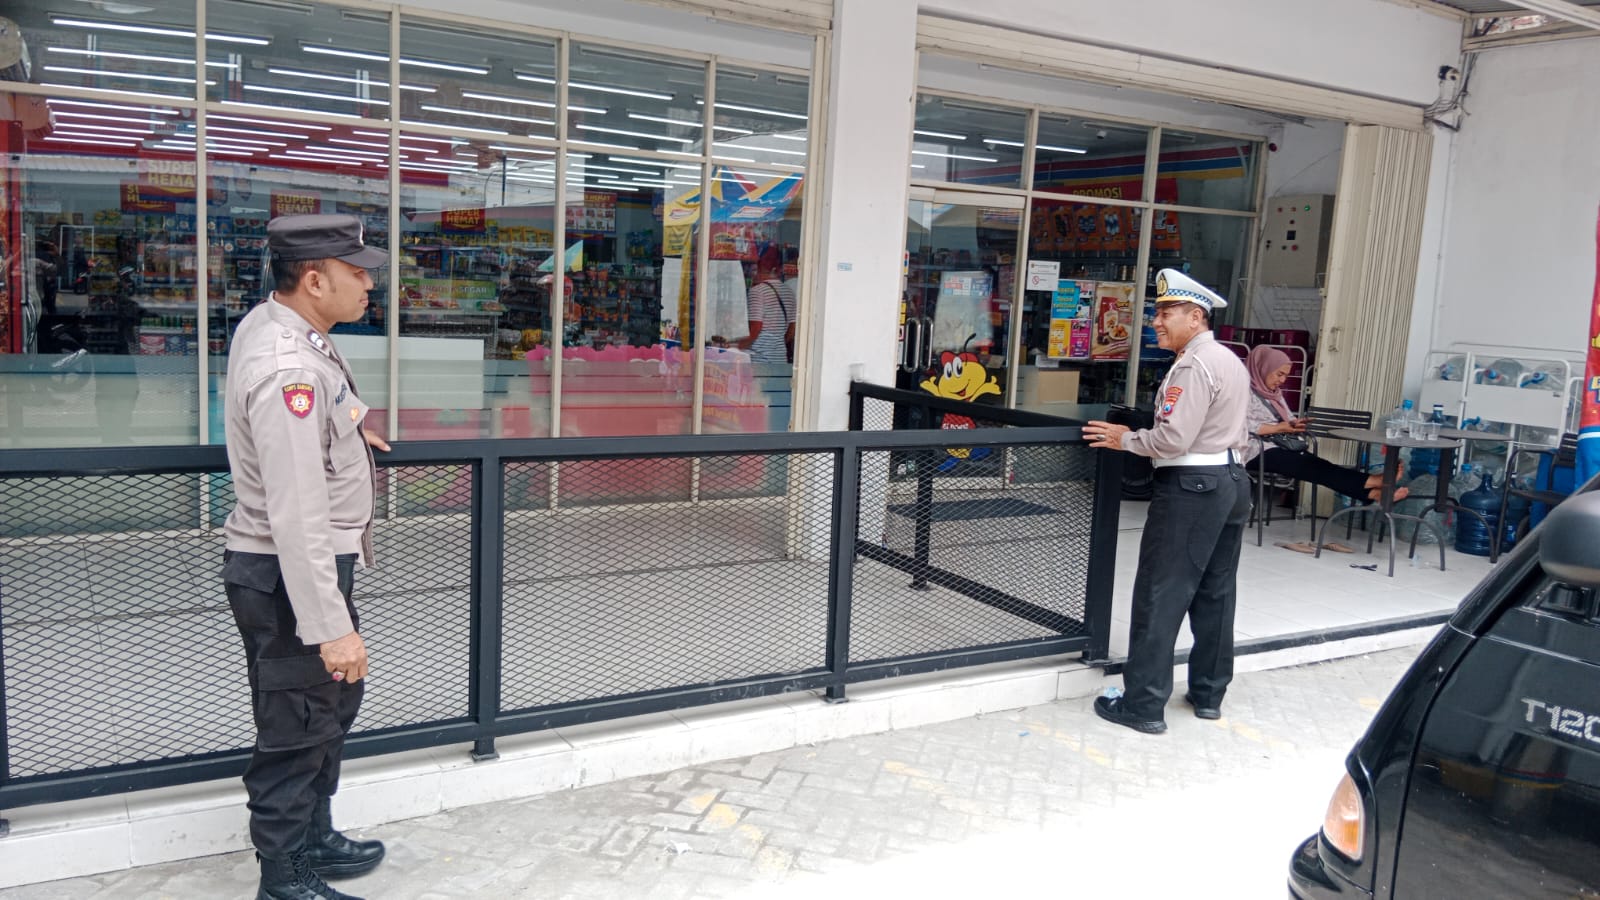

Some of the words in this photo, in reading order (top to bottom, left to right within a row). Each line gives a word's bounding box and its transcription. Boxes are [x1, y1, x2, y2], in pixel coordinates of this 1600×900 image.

[149, 160, 197, 175] SUPE
[149, 174, 197, 188] HEMA
[277, 194, 315, 206] SUPER
[277, 203, 315, 215] HEMAT
[447, 215, 480, 225] HEMAT
